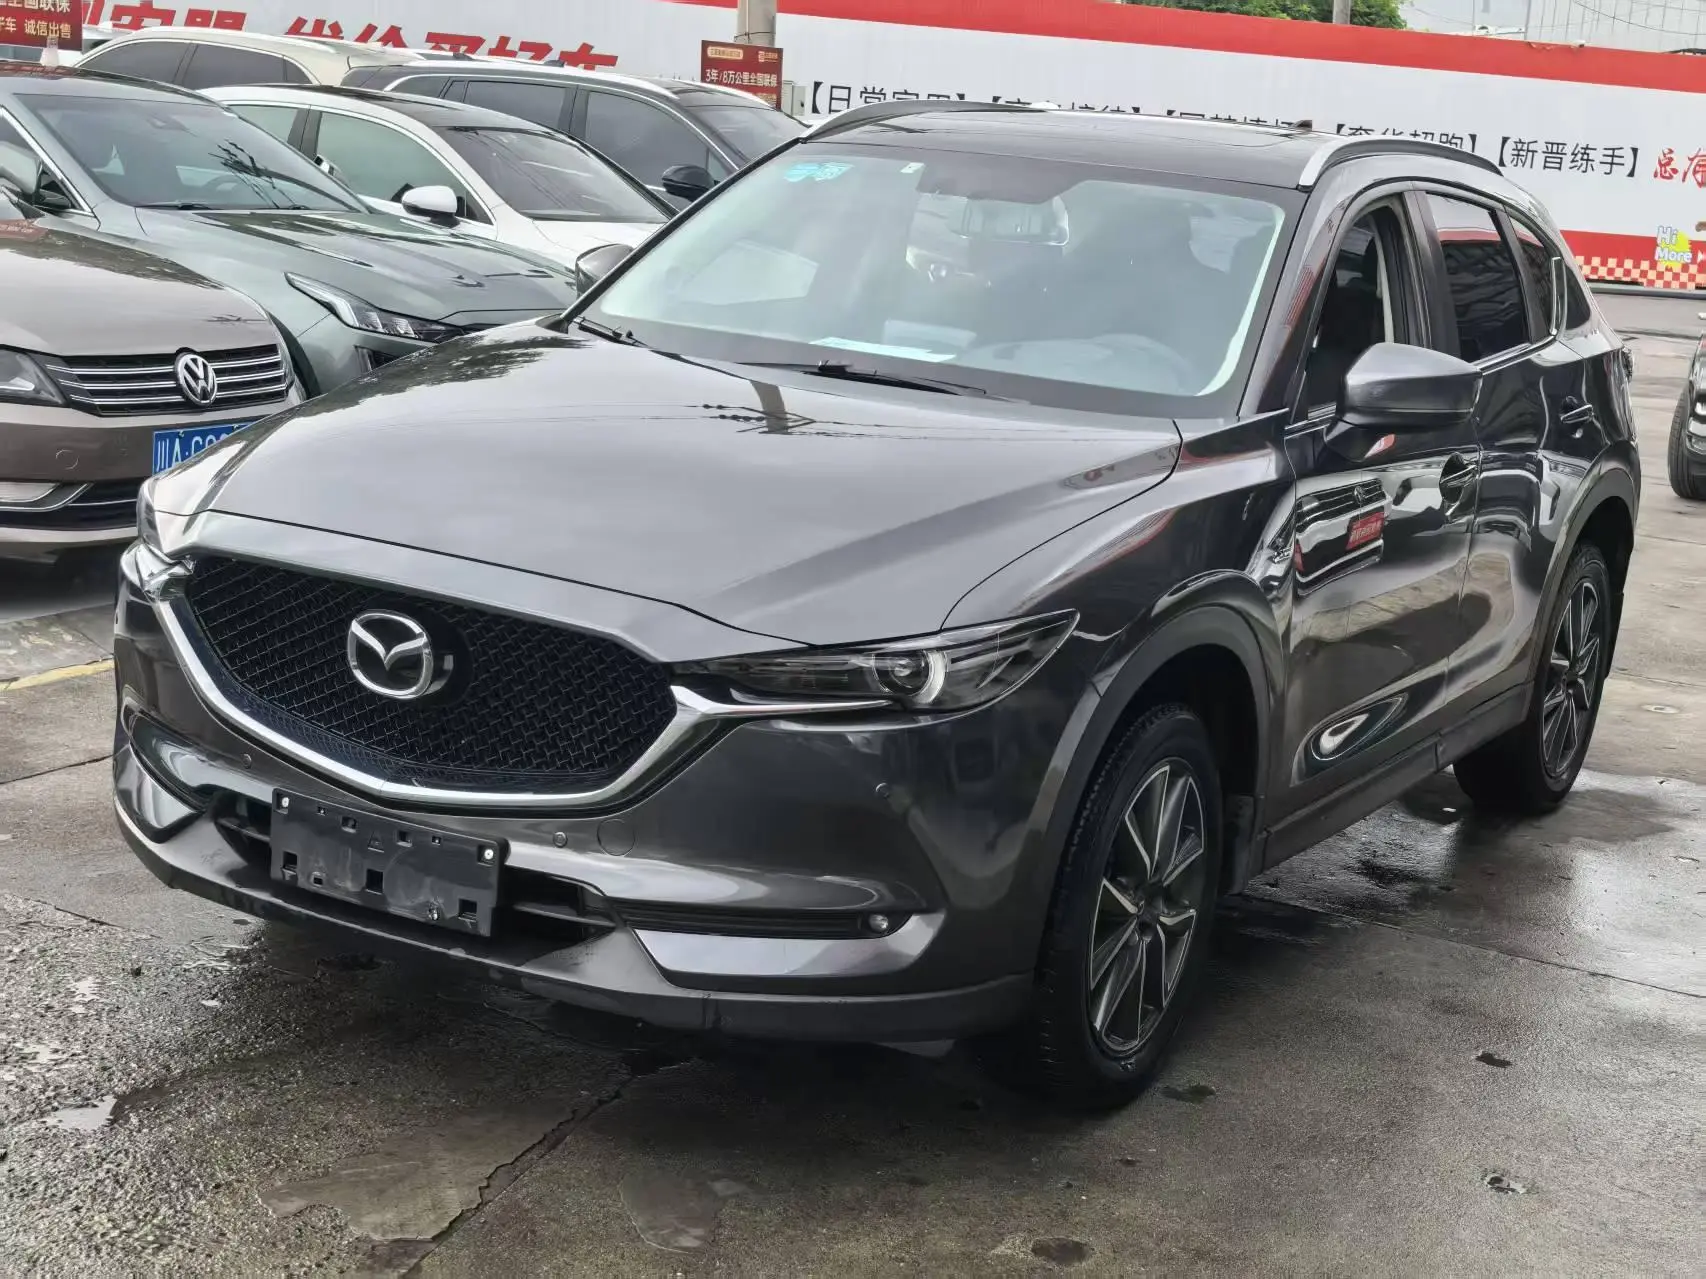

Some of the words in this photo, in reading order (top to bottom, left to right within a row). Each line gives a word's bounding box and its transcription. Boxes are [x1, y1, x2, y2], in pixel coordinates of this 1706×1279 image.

[24, 19, 71, 39] 诚信出售
[1498, 136, 1640, 178] 【新晋练手】
[1656, 225, 1679, 246] Hi
[1654, 246, 1693, 263] More
